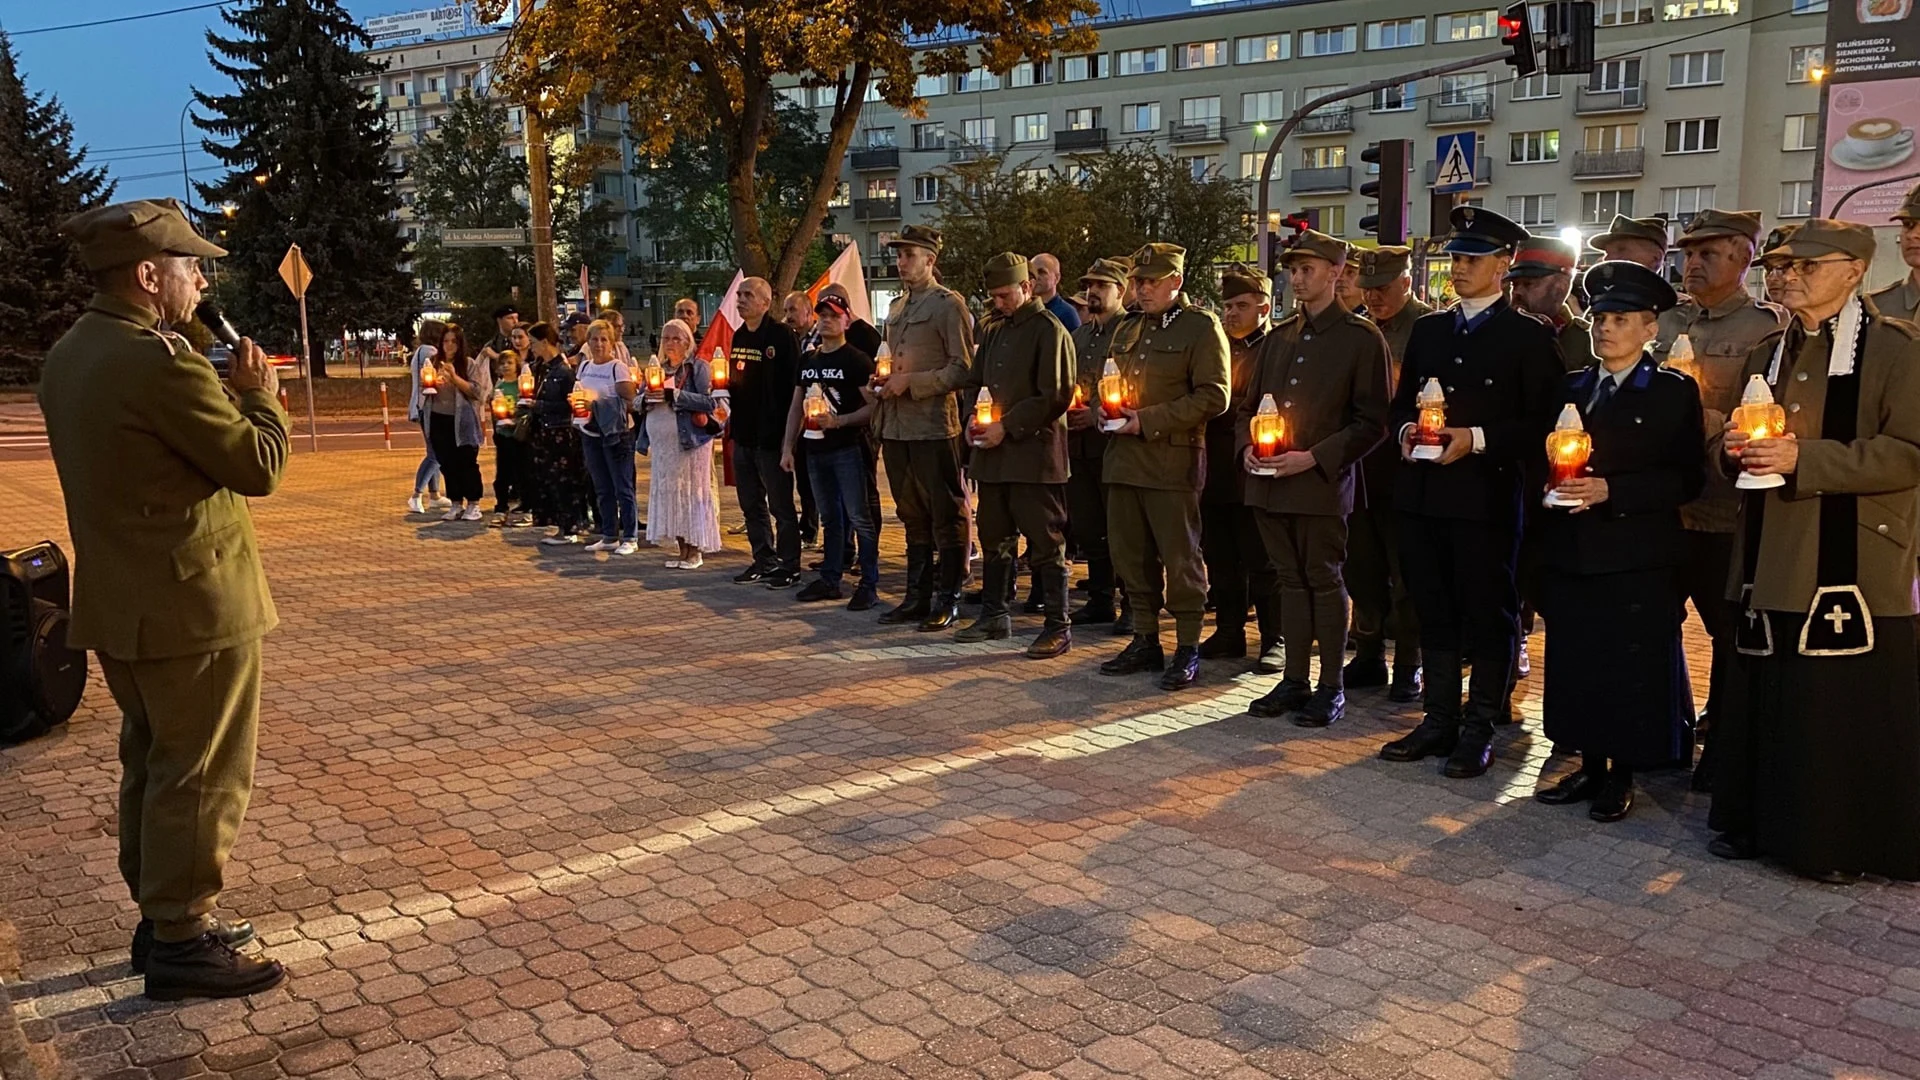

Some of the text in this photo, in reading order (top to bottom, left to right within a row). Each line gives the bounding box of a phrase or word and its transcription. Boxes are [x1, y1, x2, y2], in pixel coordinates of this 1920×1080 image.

[431, 7, 463, 21] BARTOSZ
[1836, 38, 1885, 48] KILIŃSKIEGO
[1836, 47, 1890, 57] SIENKIEWICZA
[1835, 56, 1880, 65] ZACHODNIA
[1835, 64, 1873, 73] ANTONIUK
[1874, 60, 1917, 70] FABRYCZNY
